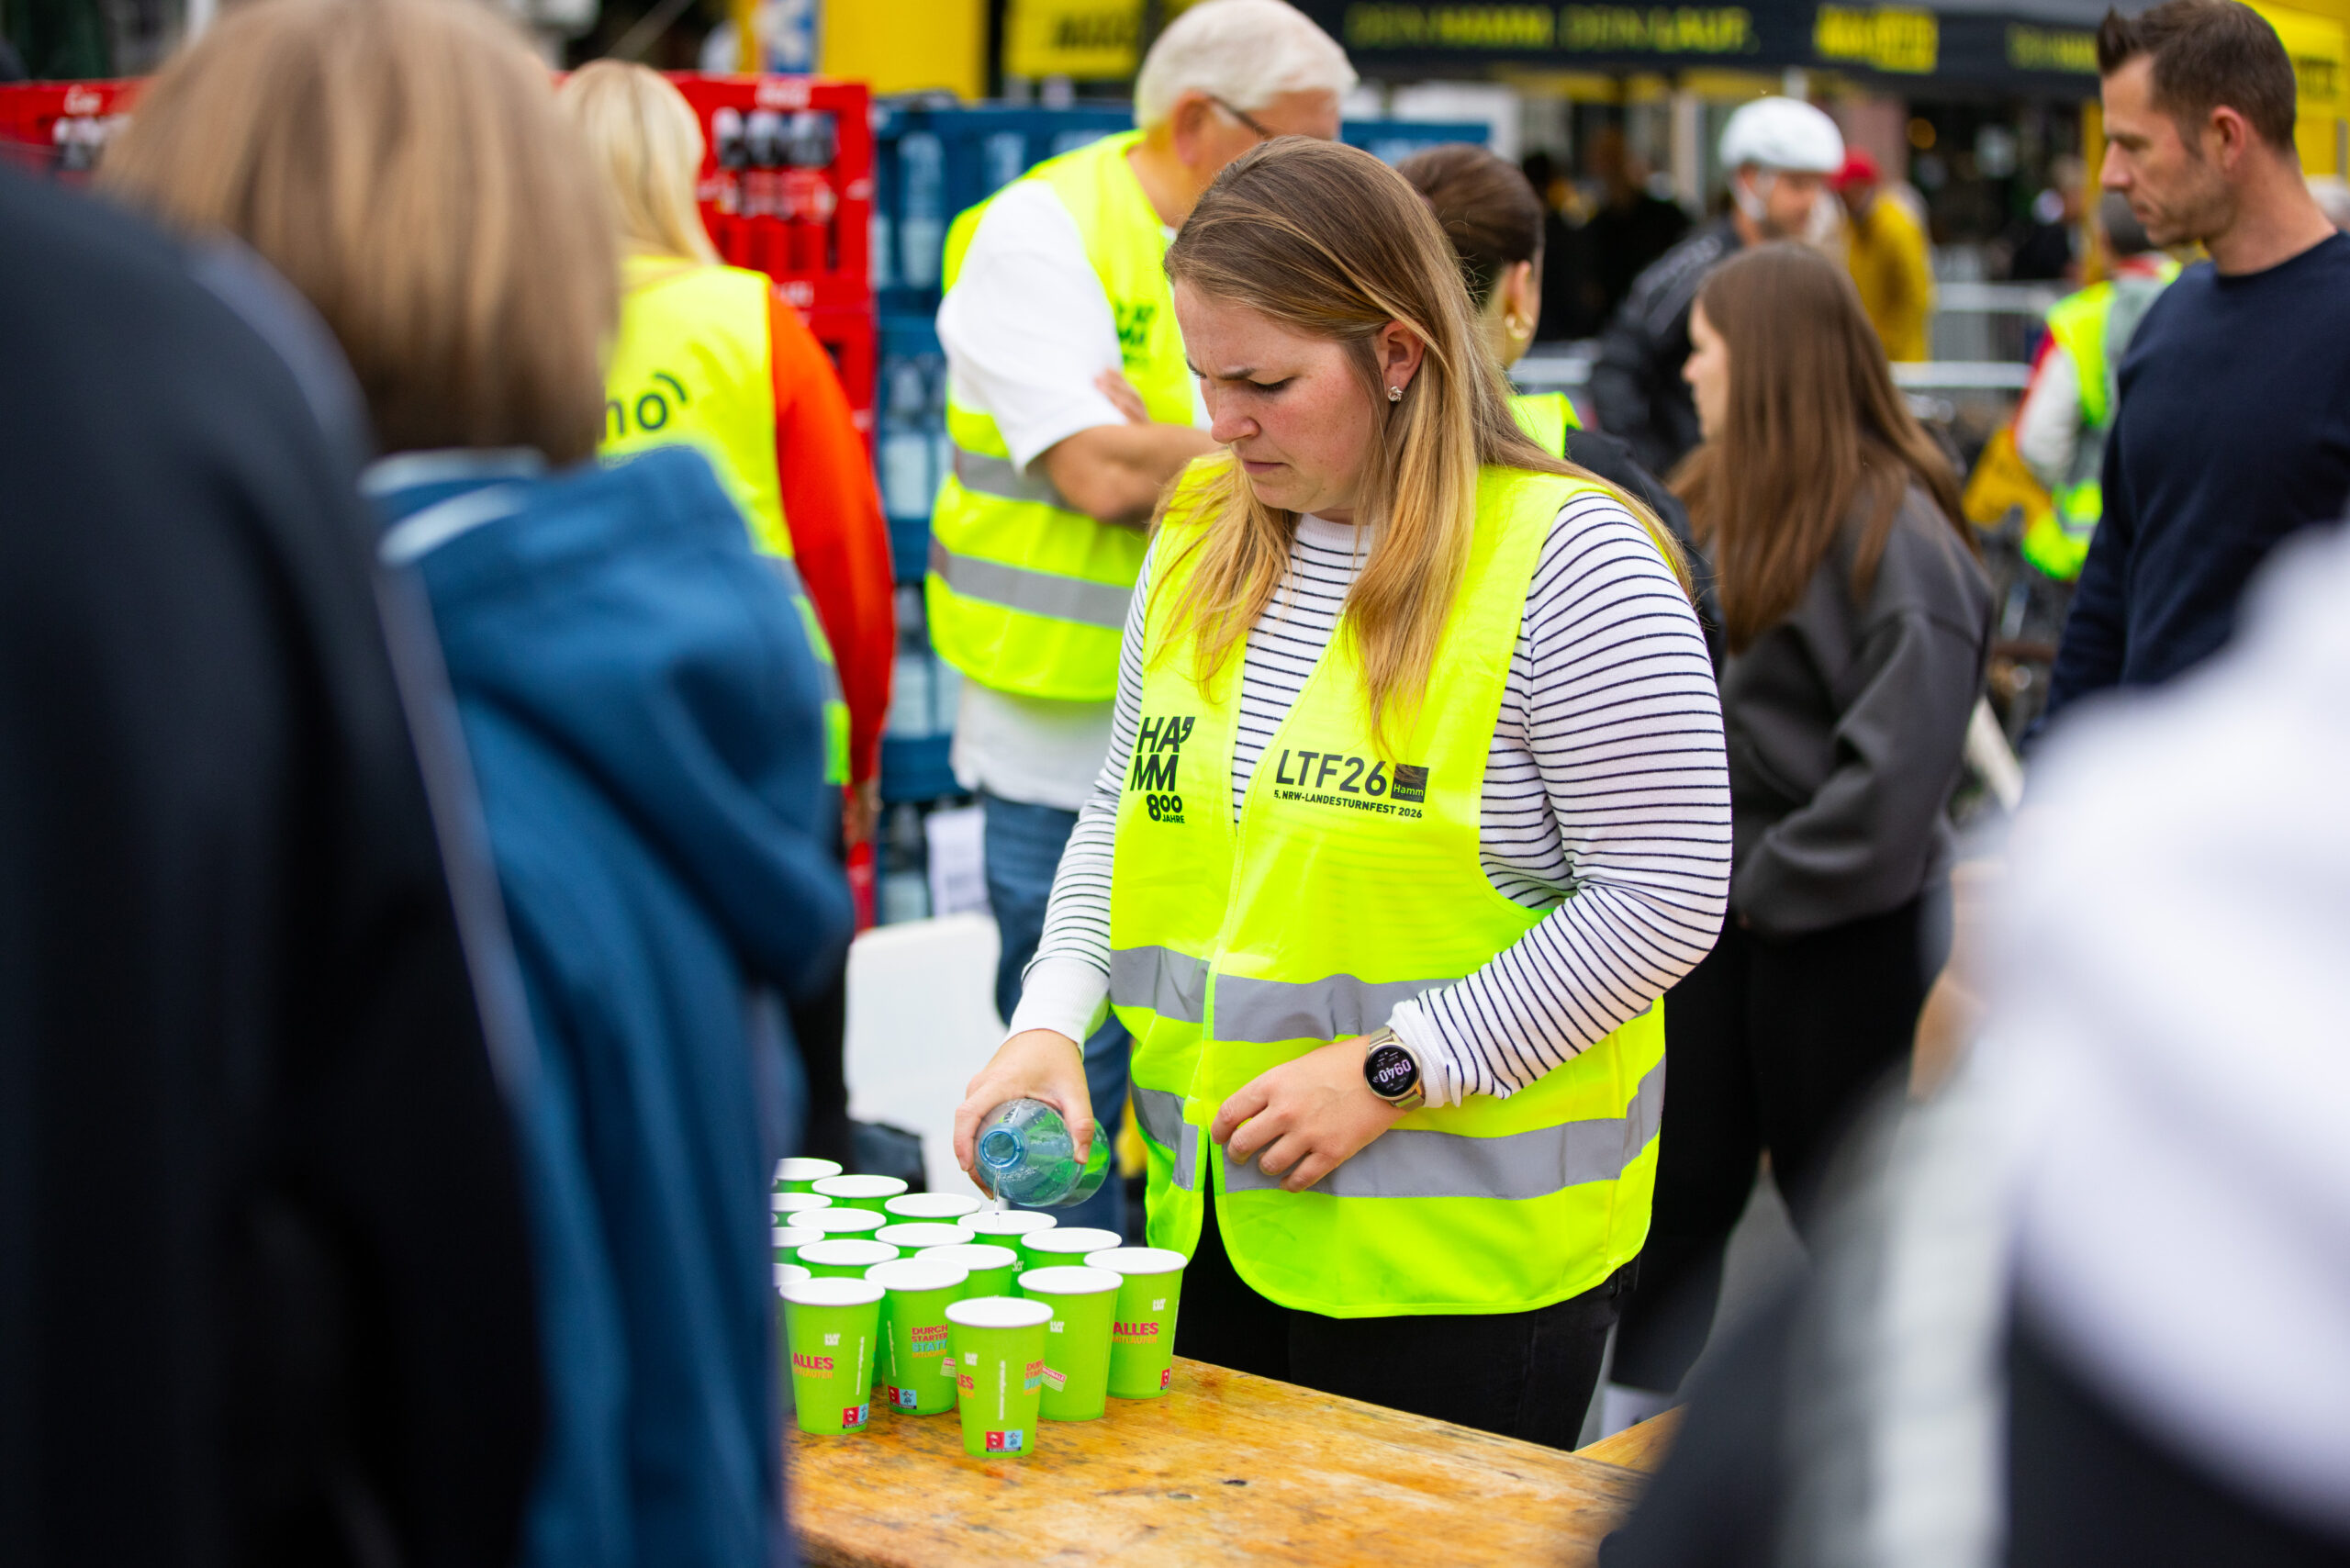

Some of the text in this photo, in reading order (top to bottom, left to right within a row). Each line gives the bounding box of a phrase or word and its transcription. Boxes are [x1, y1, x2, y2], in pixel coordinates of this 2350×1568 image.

[1130, 754, 1179, 791] MM
[1276, 749, 1387, 797] LTF26
[1393, 783, 1424, 797] Hamm
[1147, 794, 1182, 822] 800
[1274, 790, 1281, 800] 5.
[1282, 790, 1396, 815] NRW-LANDESTURNFEST
[1398, 807, 1423, 819] 2026
[1162, 814, 1185, 823] JAHRE
[912, 1324, 948, 1335] DURCH
[1113, 1321, 1158, 1336] ALLES
[912, 1332, 948, 1343] STARTER
[912, 1339, 947, 1353] STATT
[793, 1351, 834, 1371] ALLES
